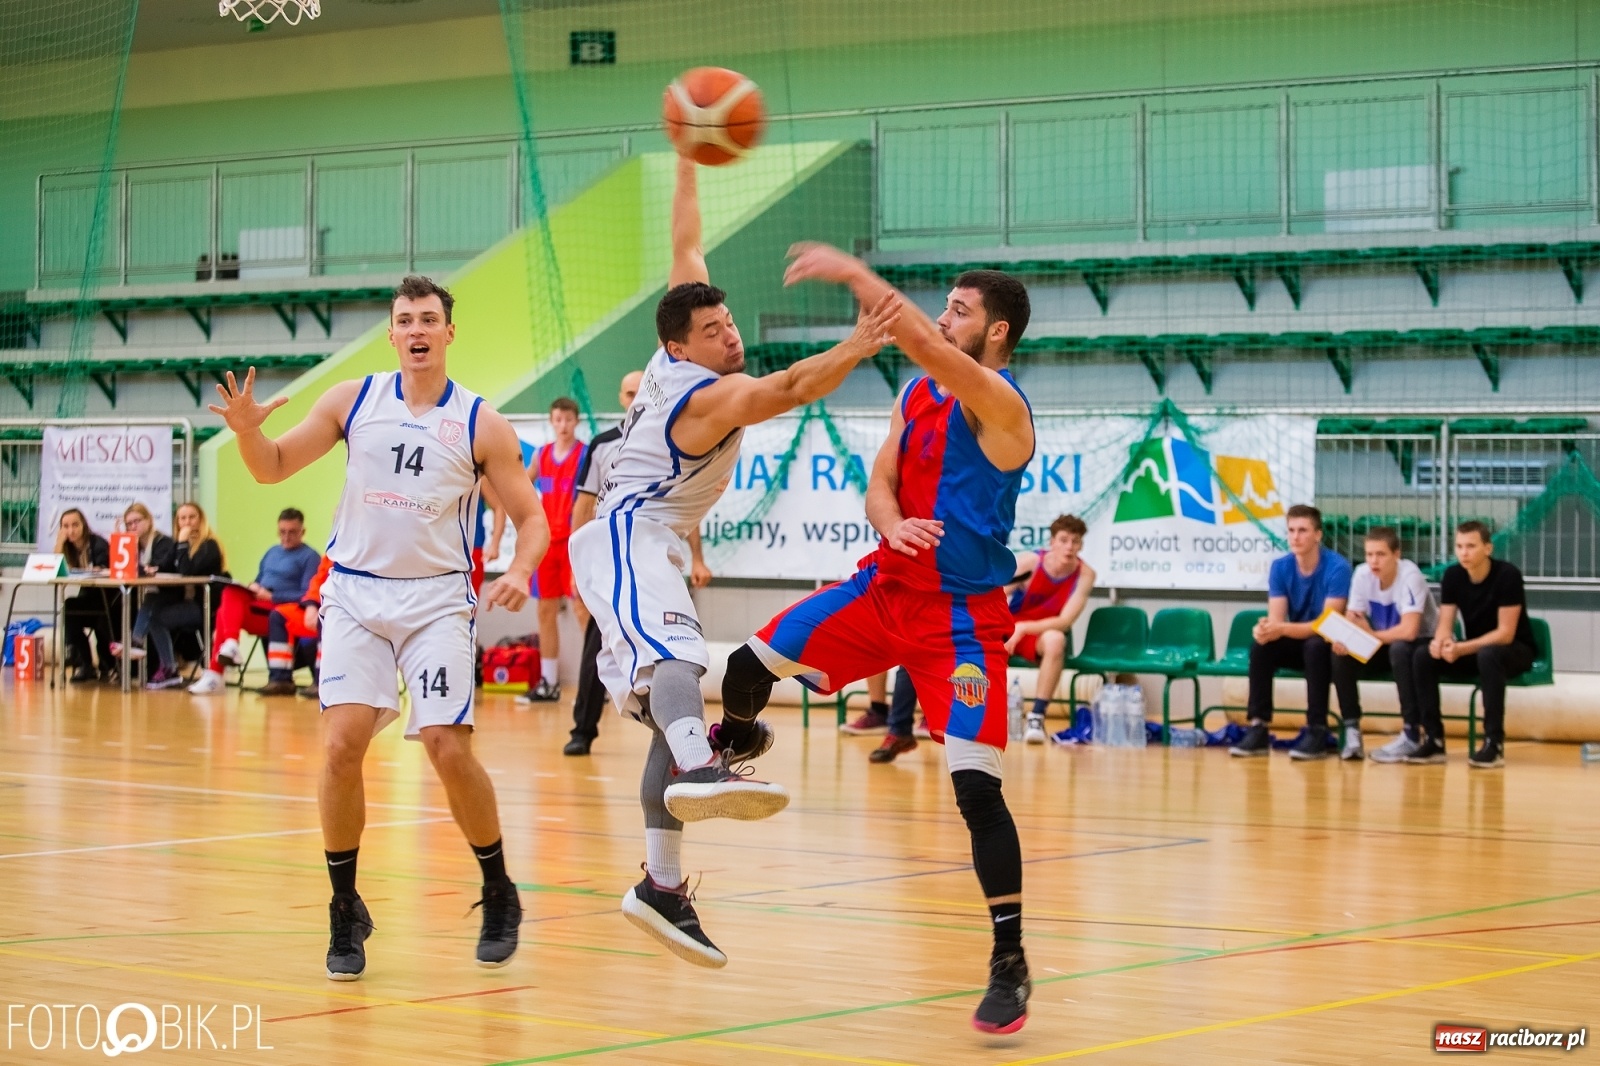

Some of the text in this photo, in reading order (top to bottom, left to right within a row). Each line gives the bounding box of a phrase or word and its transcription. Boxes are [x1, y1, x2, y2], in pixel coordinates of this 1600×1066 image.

[57, 433, 154, 463] MIESZKO
[391, 443, 424, 477] 14
[383, 498, 431, 513] KAMPKA
[114, 536, 131, 570] 5
[1110, 531, 1288, 553] powiat raciborsk
[17, 639, 31, 670] 5
[419, 667, 449, 698] 14
